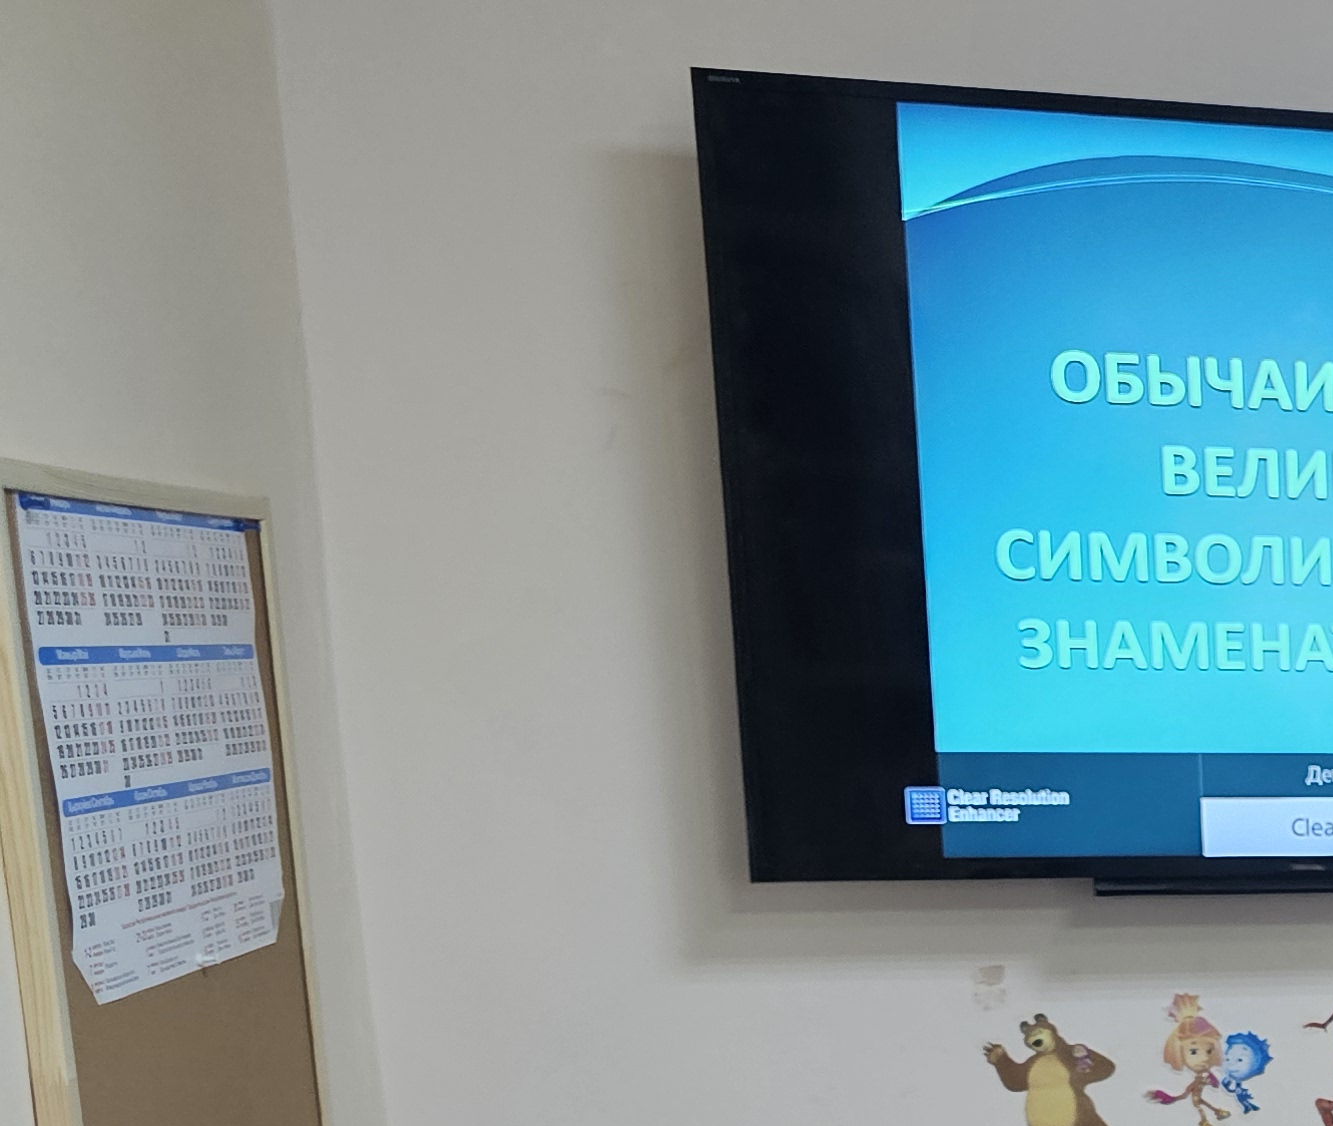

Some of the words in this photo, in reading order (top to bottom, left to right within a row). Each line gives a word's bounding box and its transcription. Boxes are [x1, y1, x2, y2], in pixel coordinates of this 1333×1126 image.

[946, 788, 989, 806] Clear
[989, 788, 1071, 806] Resolution
[948, 806, 1021, 822] Enhancer
